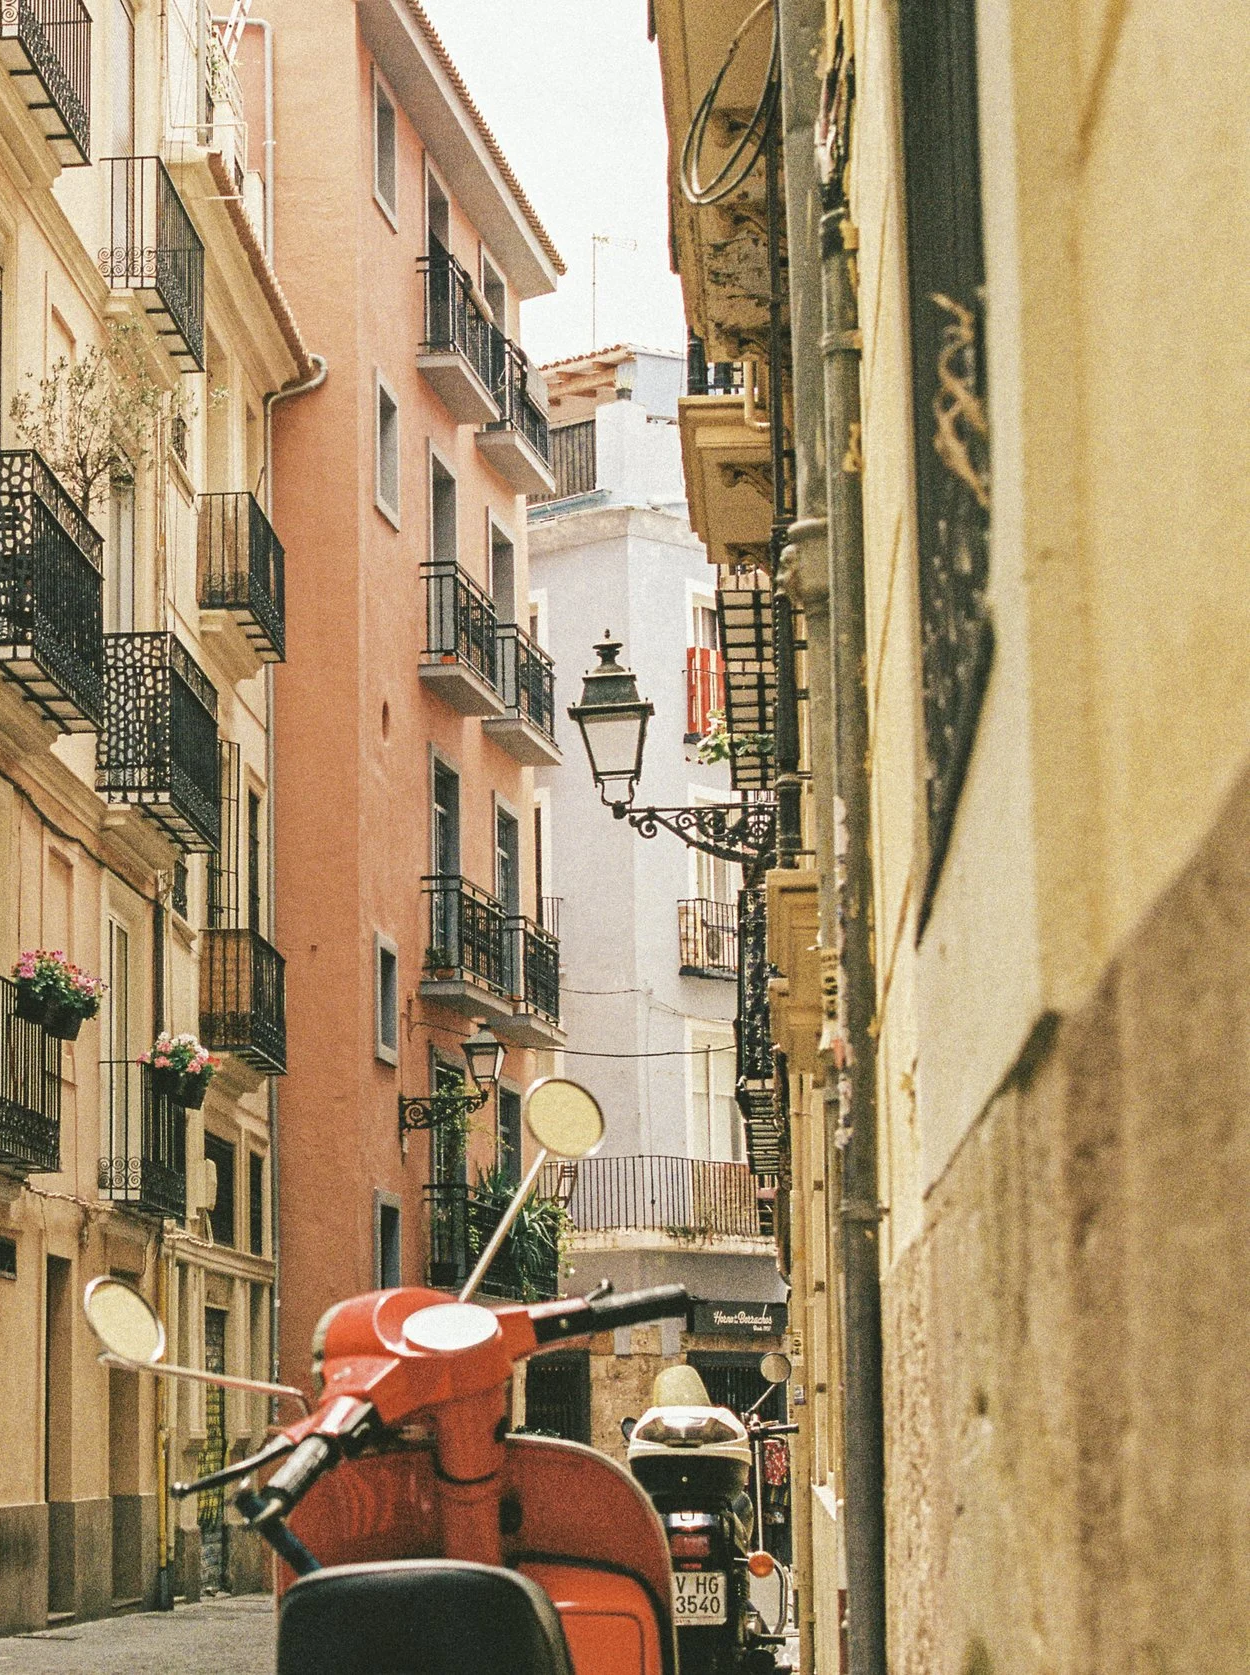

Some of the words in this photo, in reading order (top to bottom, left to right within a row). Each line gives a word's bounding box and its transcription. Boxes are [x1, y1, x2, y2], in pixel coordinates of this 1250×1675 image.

[676, 1576, 686, 1594] V
[696, 1576, 719, 1594] HG
[675, 1595, 721, 1614] 3540
